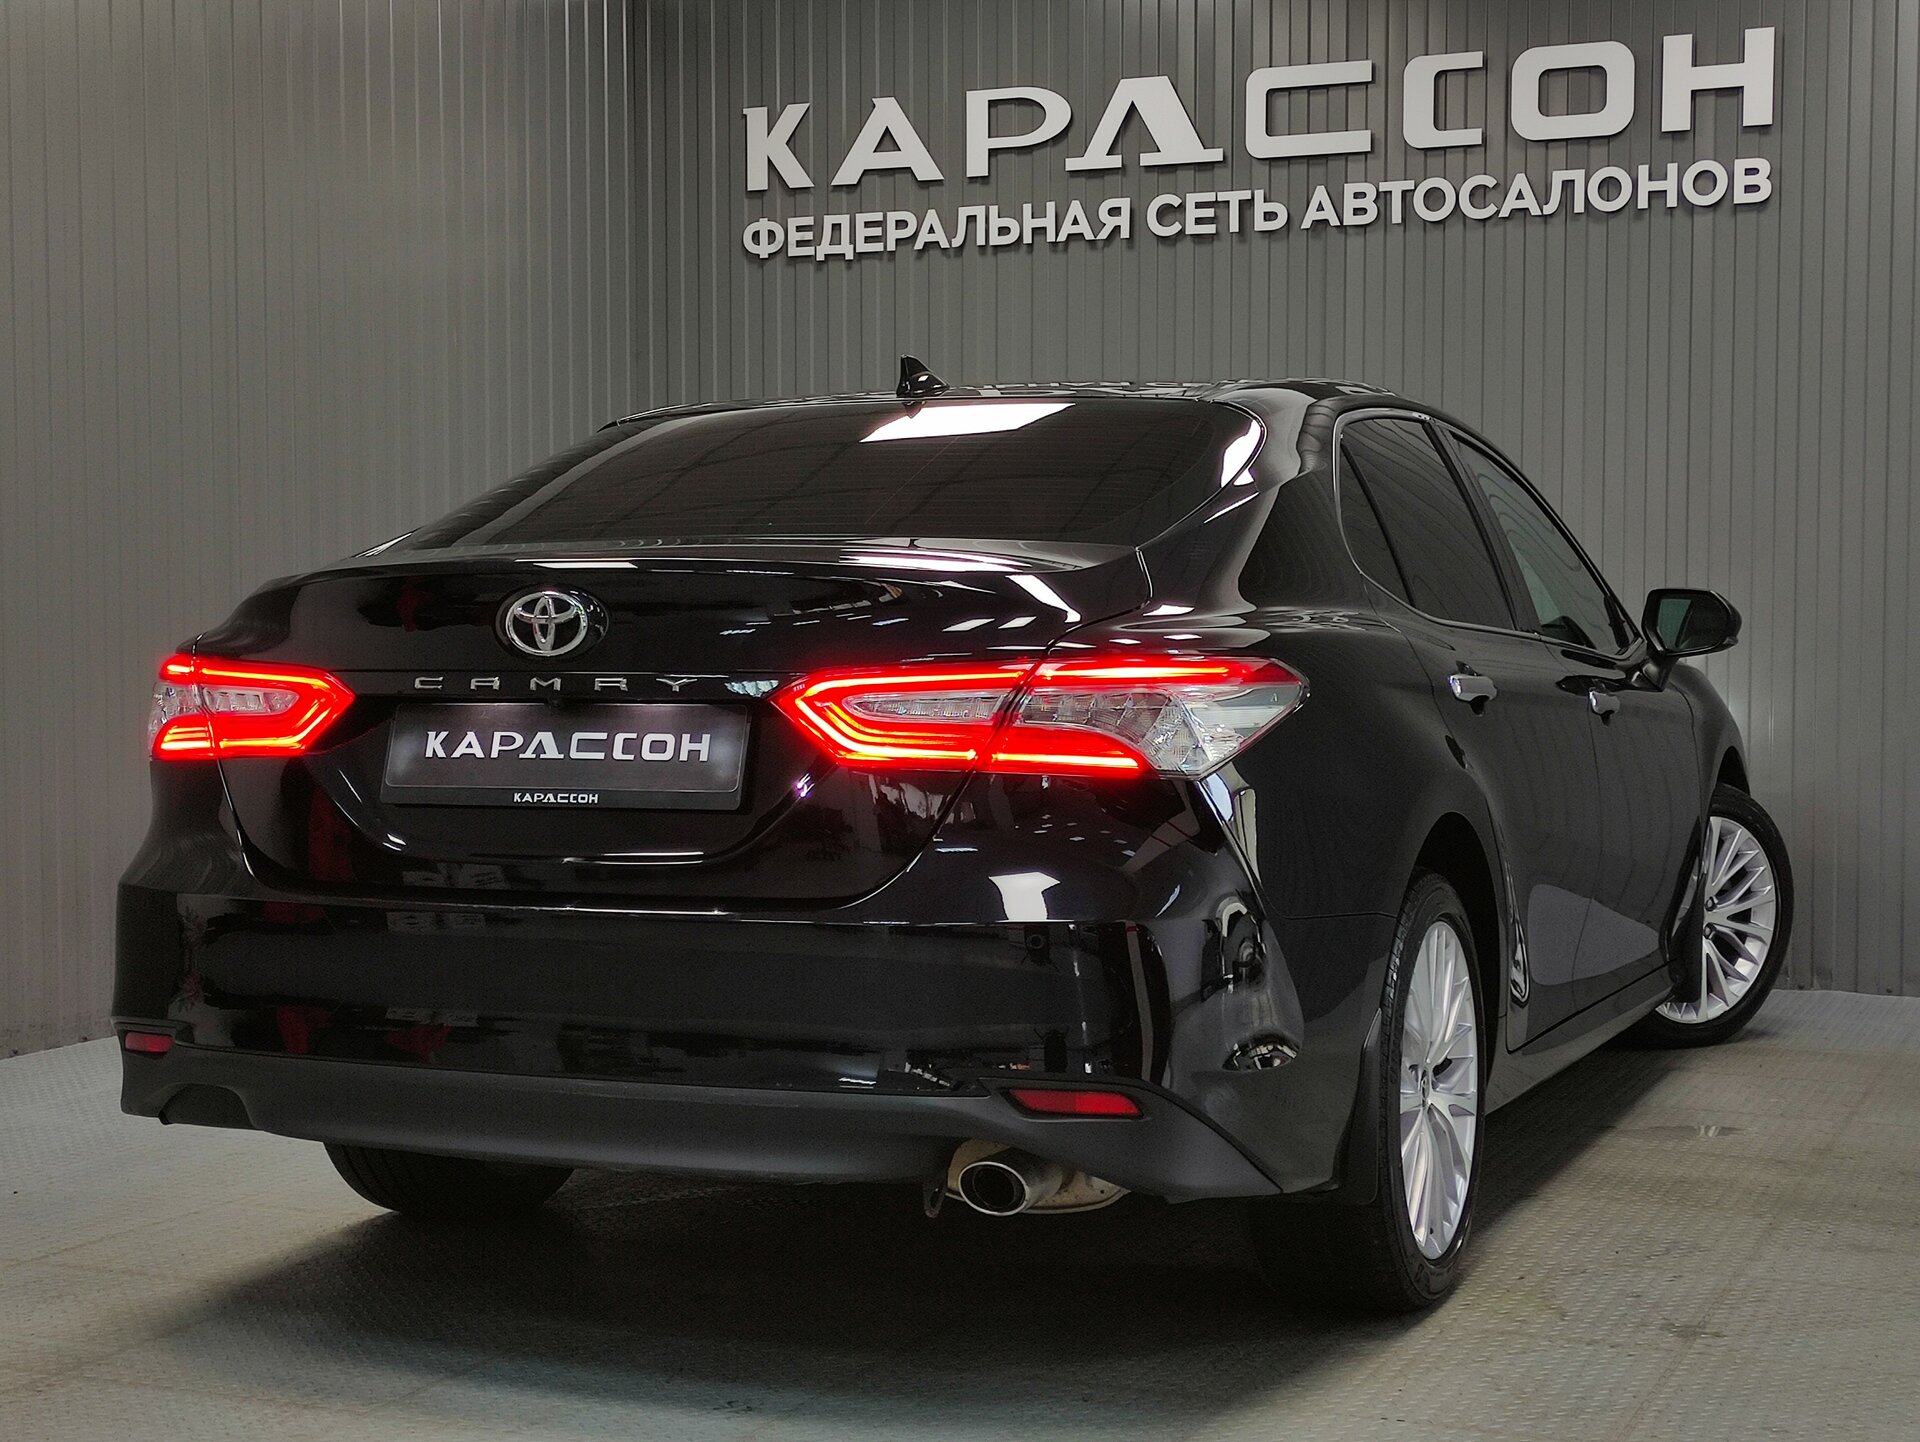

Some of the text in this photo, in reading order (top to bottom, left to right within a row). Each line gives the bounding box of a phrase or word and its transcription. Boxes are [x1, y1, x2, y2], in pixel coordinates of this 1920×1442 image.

[742, 157, 1772, 261] ФЕДЕРАЛЬНАЯ СЕТЬ АВТОСАЛОНОВ
[414, 676, 698, 692] CAMRY
